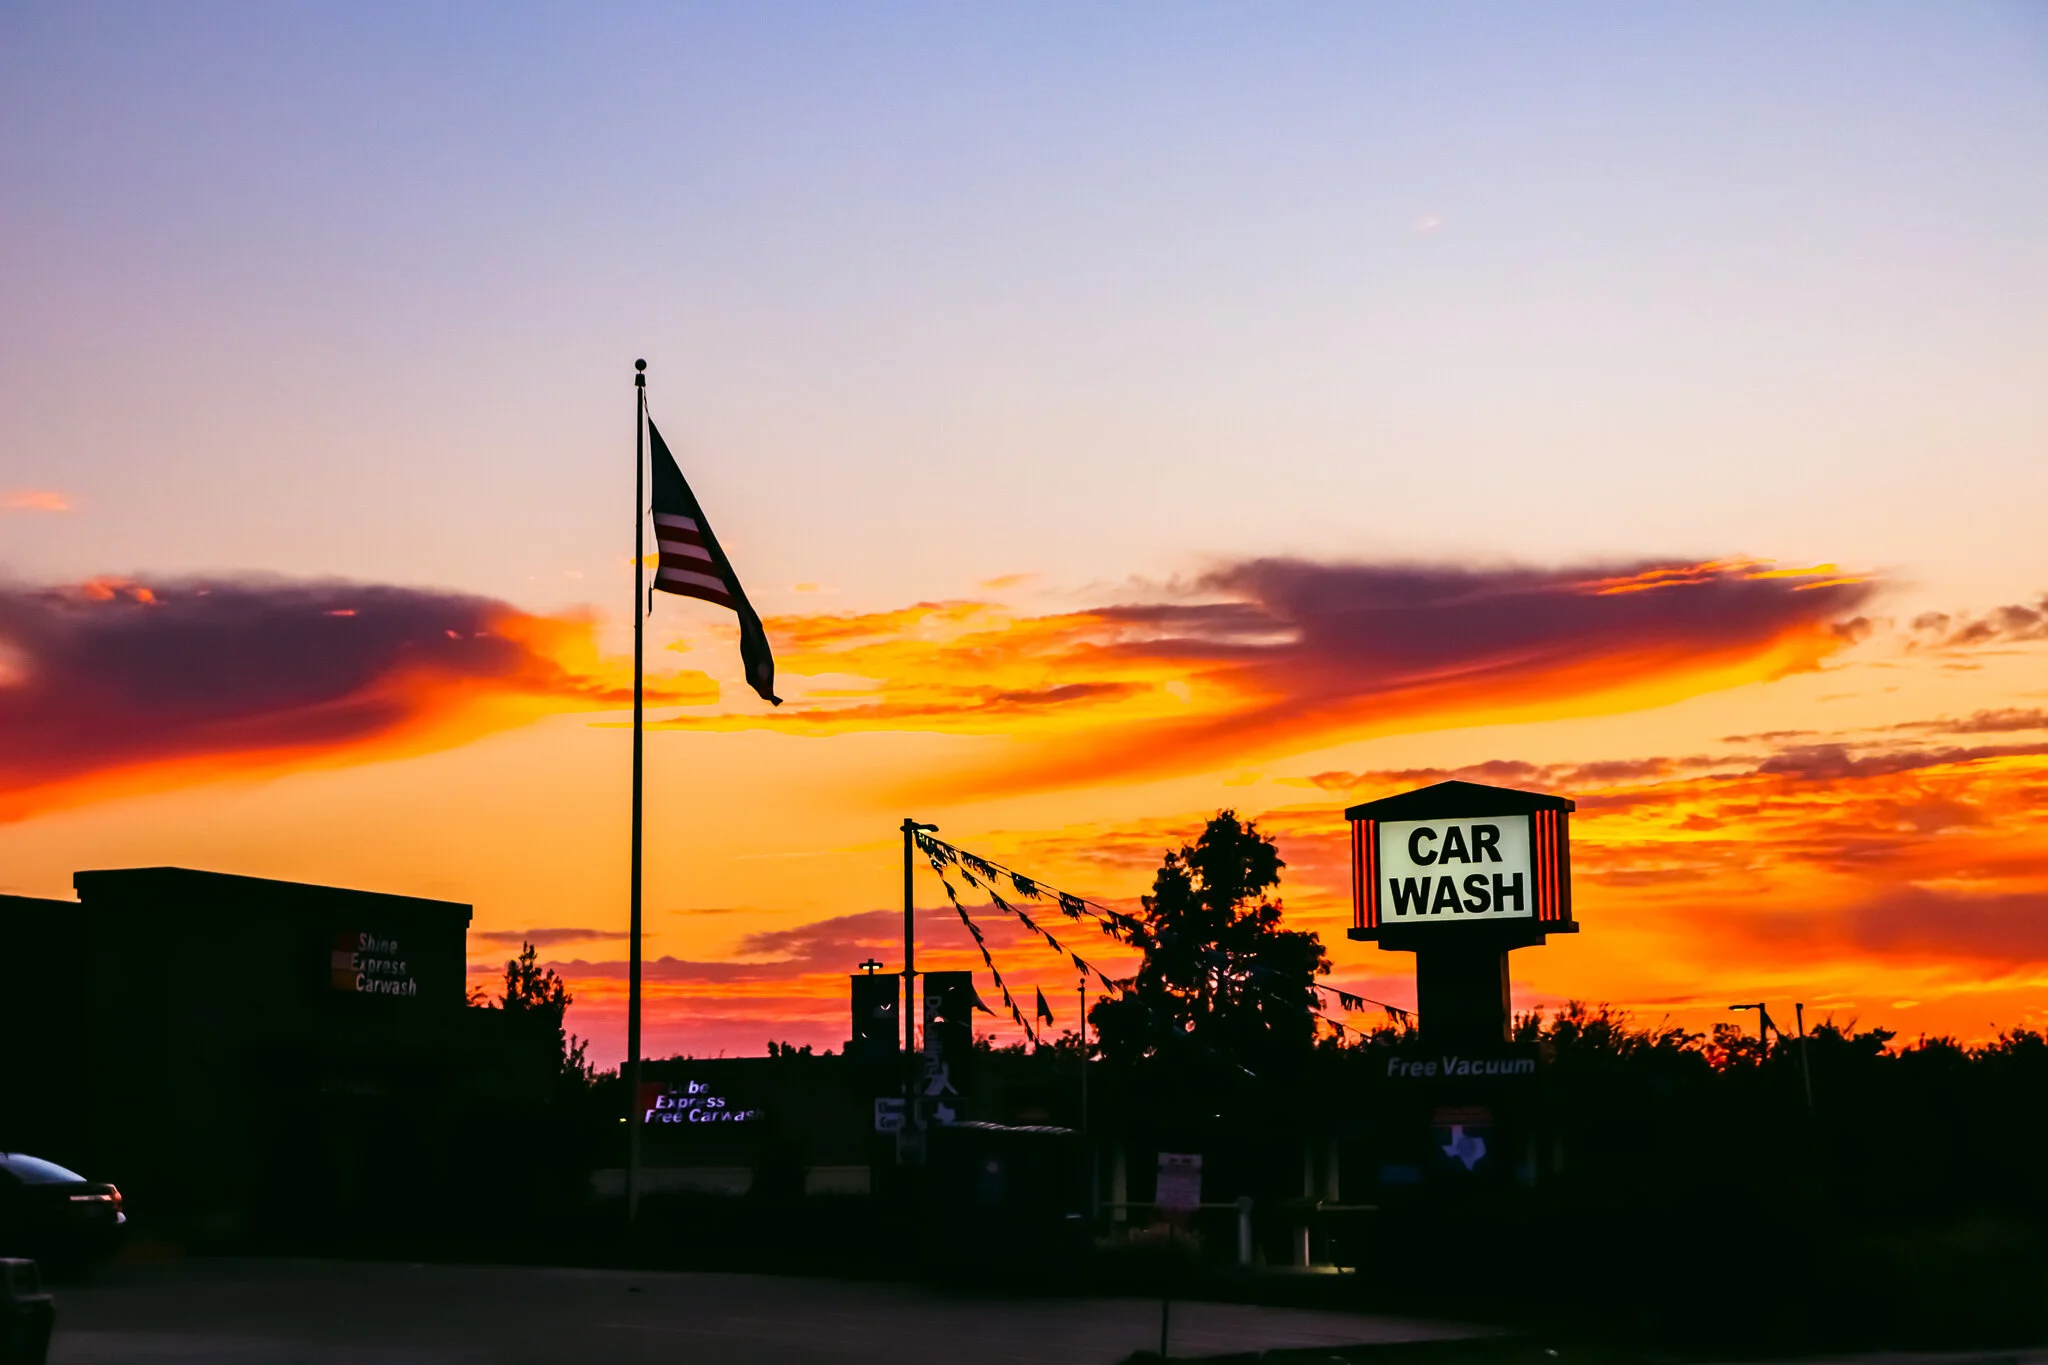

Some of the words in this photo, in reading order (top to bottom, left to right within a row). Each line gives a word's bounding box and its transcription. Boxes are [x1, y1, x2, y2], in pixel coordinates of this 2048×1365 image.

[1408, 824, 1503, 866] CAR
[1389, 872, 1524, 916] WASH
[358, 932, 399, 956] Shine
[350, 951, 408, 978] Express
[355, 971, 417, 997] Carwash
[1387, 1056, 1438, 1077] Free
[1442, 1055, 1536, 1076] Vacuum
[644, 1108, 684, 1124] Free
